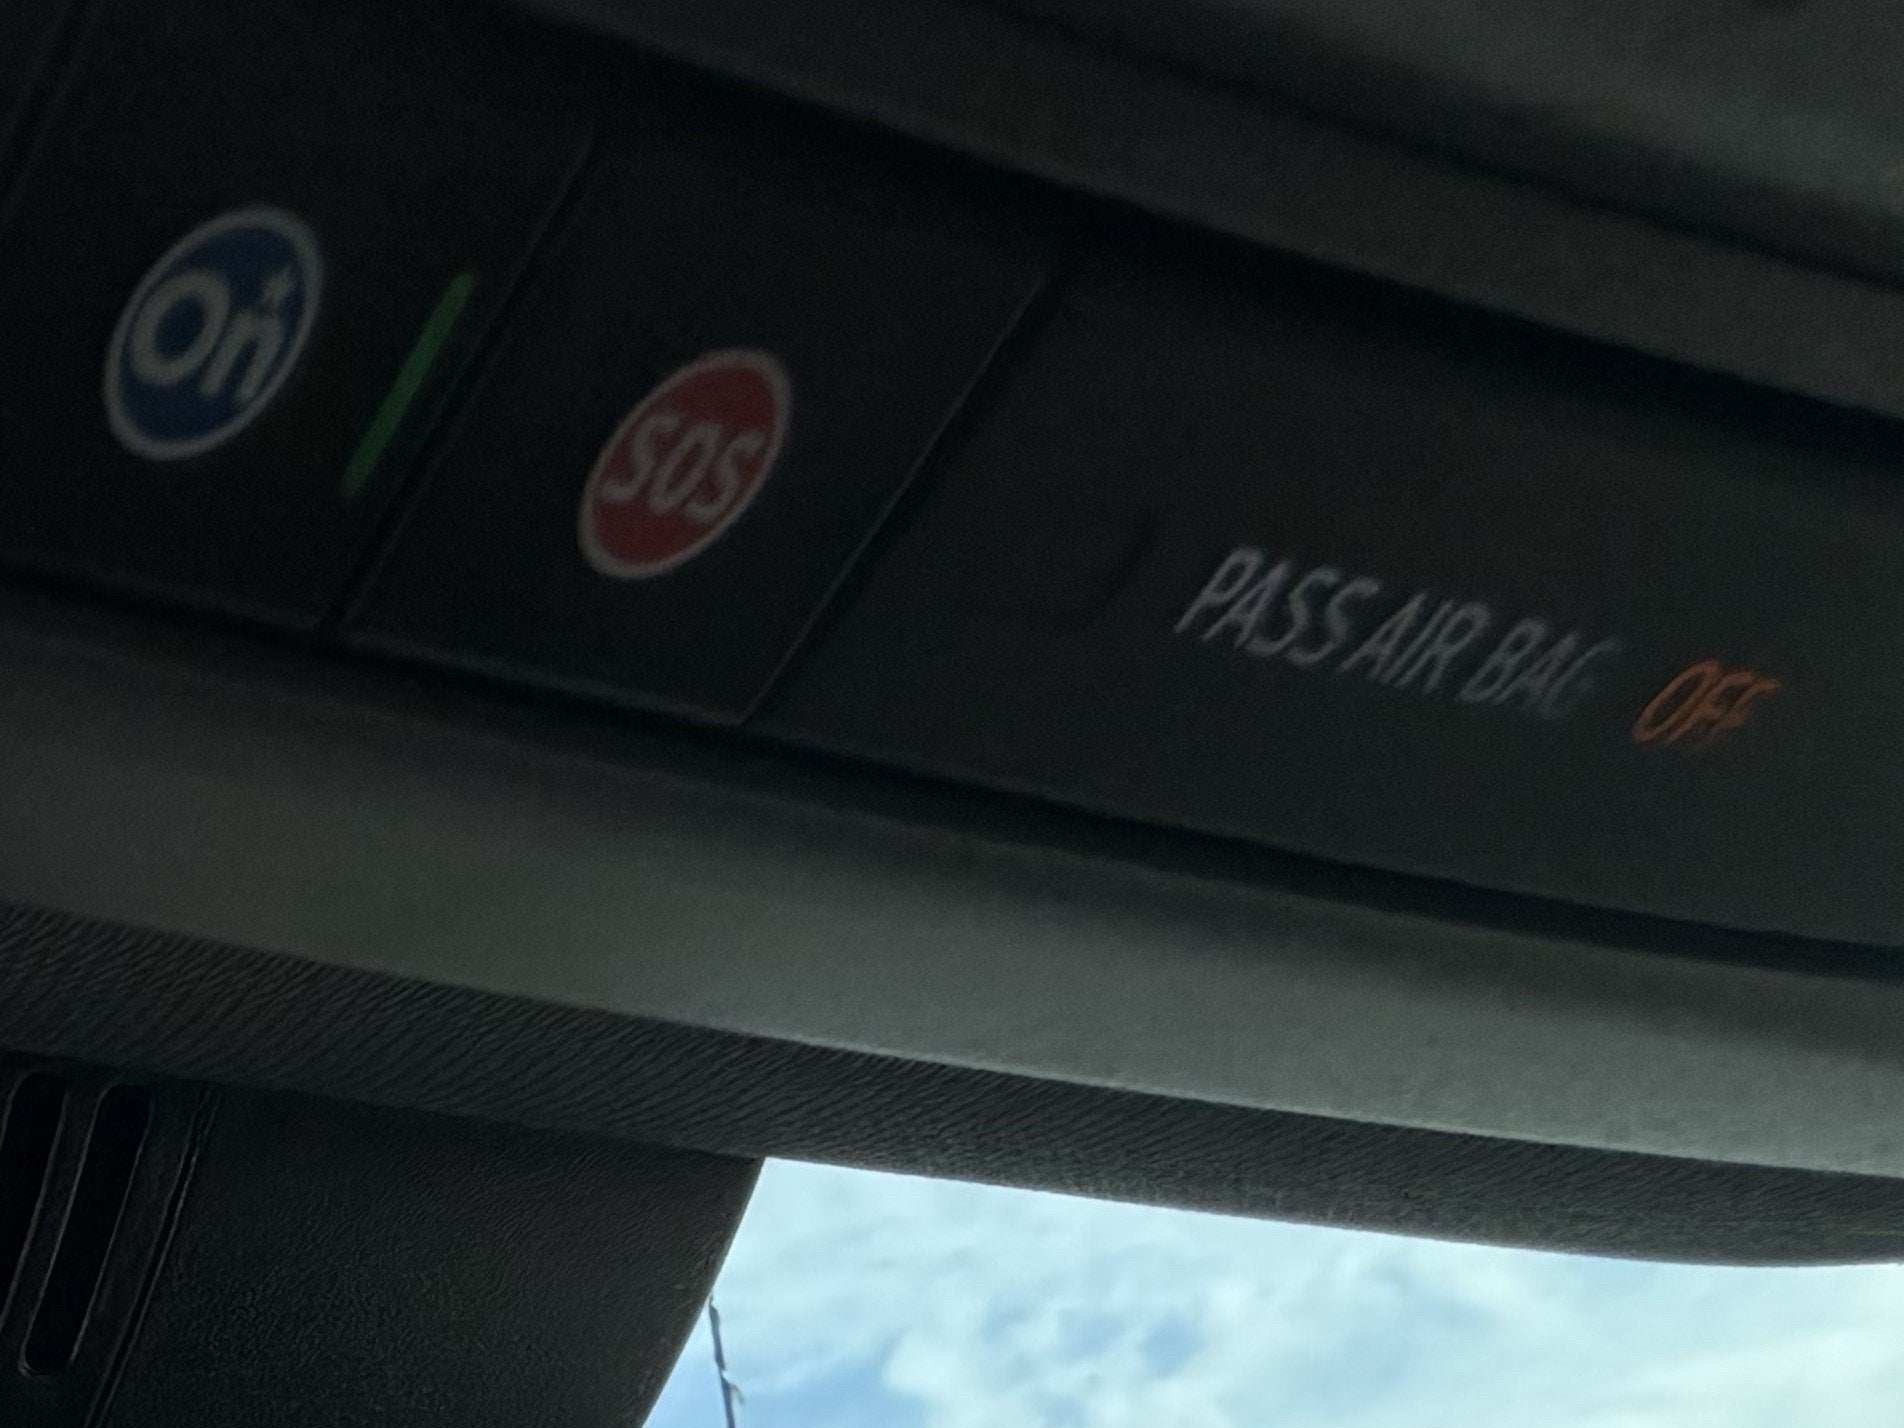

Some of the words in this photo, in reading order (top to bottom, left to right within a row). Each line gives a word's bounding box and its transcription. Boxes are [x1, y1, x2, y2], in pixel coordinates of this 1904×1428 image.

[128, 266, 285, 403] On
[599, 410, 766, 521] SOS
[1173, 544, 1382, 667] PASS
[1338, 589, 1493, 697] AIR
[1632, 657, 1782, 748] OFF
